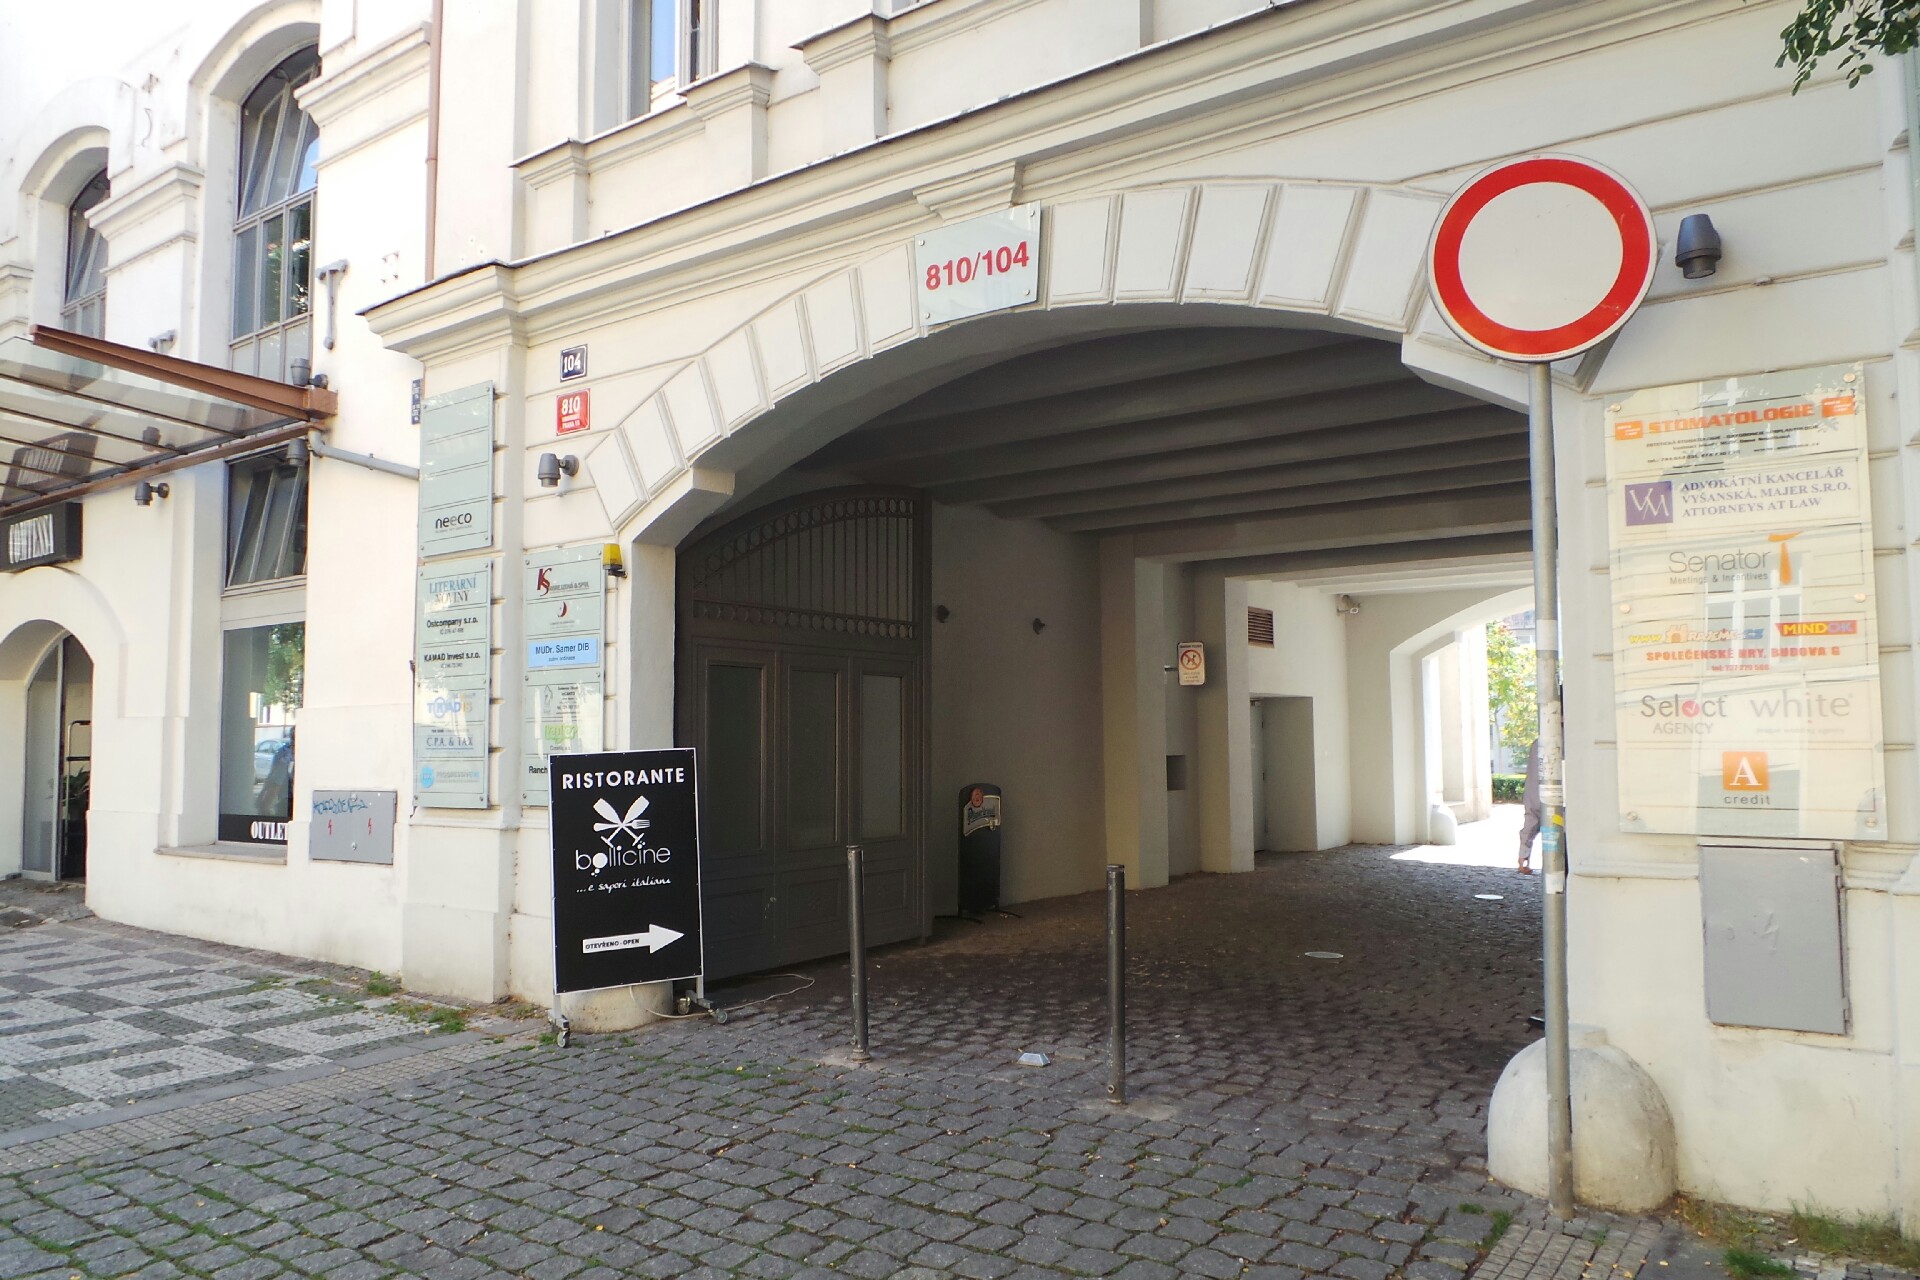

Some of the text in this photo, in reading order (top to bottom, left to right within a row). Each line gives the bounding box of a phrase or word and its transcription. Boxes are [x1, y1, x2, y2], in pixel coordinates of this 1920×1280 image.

[926, 241, 1030, 290] 810/104
[563, 353, 581, 373] 104
[561, 395, 581, 415] 810
[1648, 403, 1815, 433] STOMATOLOGIE
[1681, 466, 1845, 492] ADVOKÁTNÍ KANCELÁŘ
[1682, 481, 1852, 504] VYŠANSKÁ, MAJER S.R.O.
[1682, 496, 1822, 518] ATTORNEYS AT LAW
[435, 512, 472, 529] neeco
[1668, 548, 1771, 573] Senator
[1669, 572, 1769, 585] Meetings & Incentives
[463, 616, 479, 624] s.r.o.
[1783, 622, 1852, 636] MINDOK
[535, 642, 590, 655] MUDr. Samer DIB
[1646, 646, 1735, 661] SPOLEČENSKÉ
[1771, 646, 1827, 658] BUDOVA
[1750, 688, 1850, 718] white
[1652, 722, 1713, 735] AGENCY
[457, 736, 473, 746] TAX
[562, 767, 685, 789] RISTORANTE
[1729, 755, 1762, 786] A
[1724, 794, 1771, 805] credit
[575, 845, 671, 871] bollicine
[598, 878, 628, 894] sapori
[622, 938, 640, 946] OPEN
